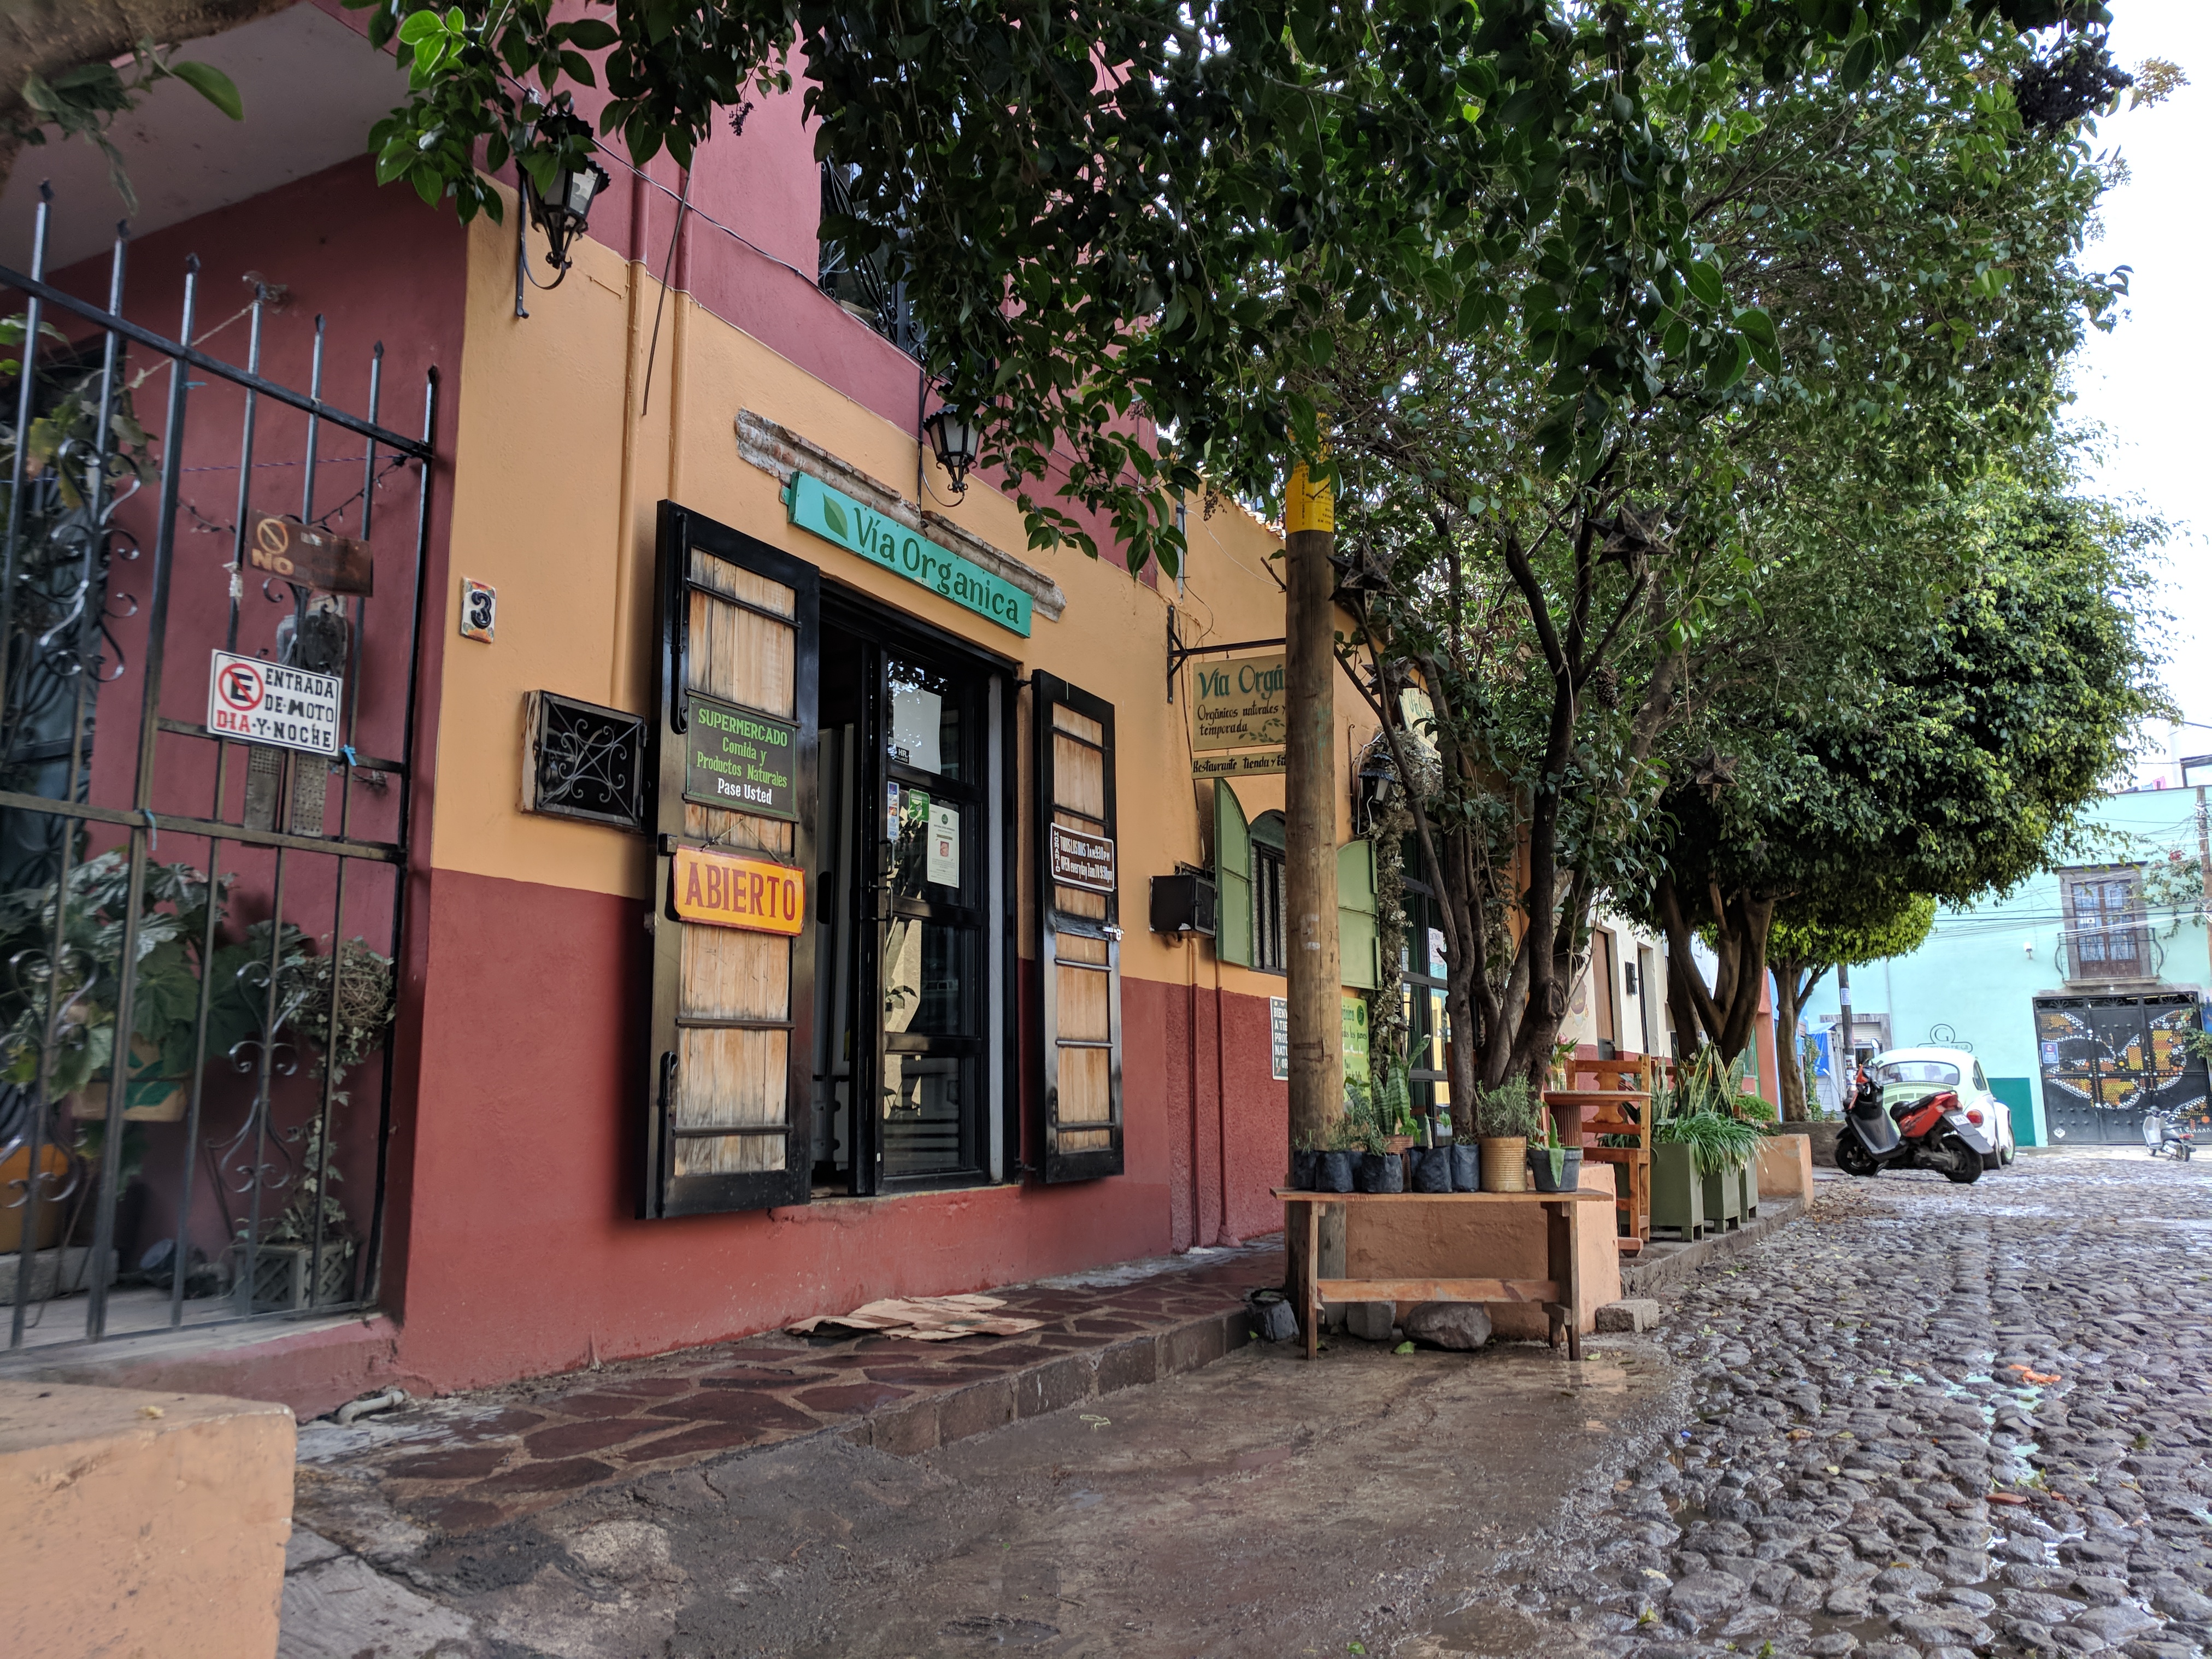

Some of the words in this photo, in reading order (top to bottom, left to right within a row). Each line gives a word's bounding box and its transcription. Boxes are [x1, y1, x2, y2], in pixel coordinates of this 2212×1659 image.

[252, 548, 294, 576] NO
[854, 507, 895, 562] Vía
[903, 538, 1019, 624] Organica
[471, 591, 492, 630] 3
[265, 667, 334, 699] ENTRADA
[1238, 664, 1286, 700] Orgá
[1243, 700, 1279, 717] naturales
[273, 721, 332, 748] NOCHE
[698, 707, 788, 748] SUPERMERCADO
[1199, 719, 1248, 739] temporada
[722, 736, 757, 760] Comida
[760, 749, 767, 766] y
[1193, 757, 1237, 773] Restaurante
[697, 751, 743, 778] Productos
[747, 763, 787, 789] Naturales
[717, 778, 742, 798] Pase
[744, 784, 773, 805] Usted
[685, 861, 796, 921] ABIERTO
[1275, 1020, 1279, 1029] A
[1934, 1027, 1949, 1042] G
